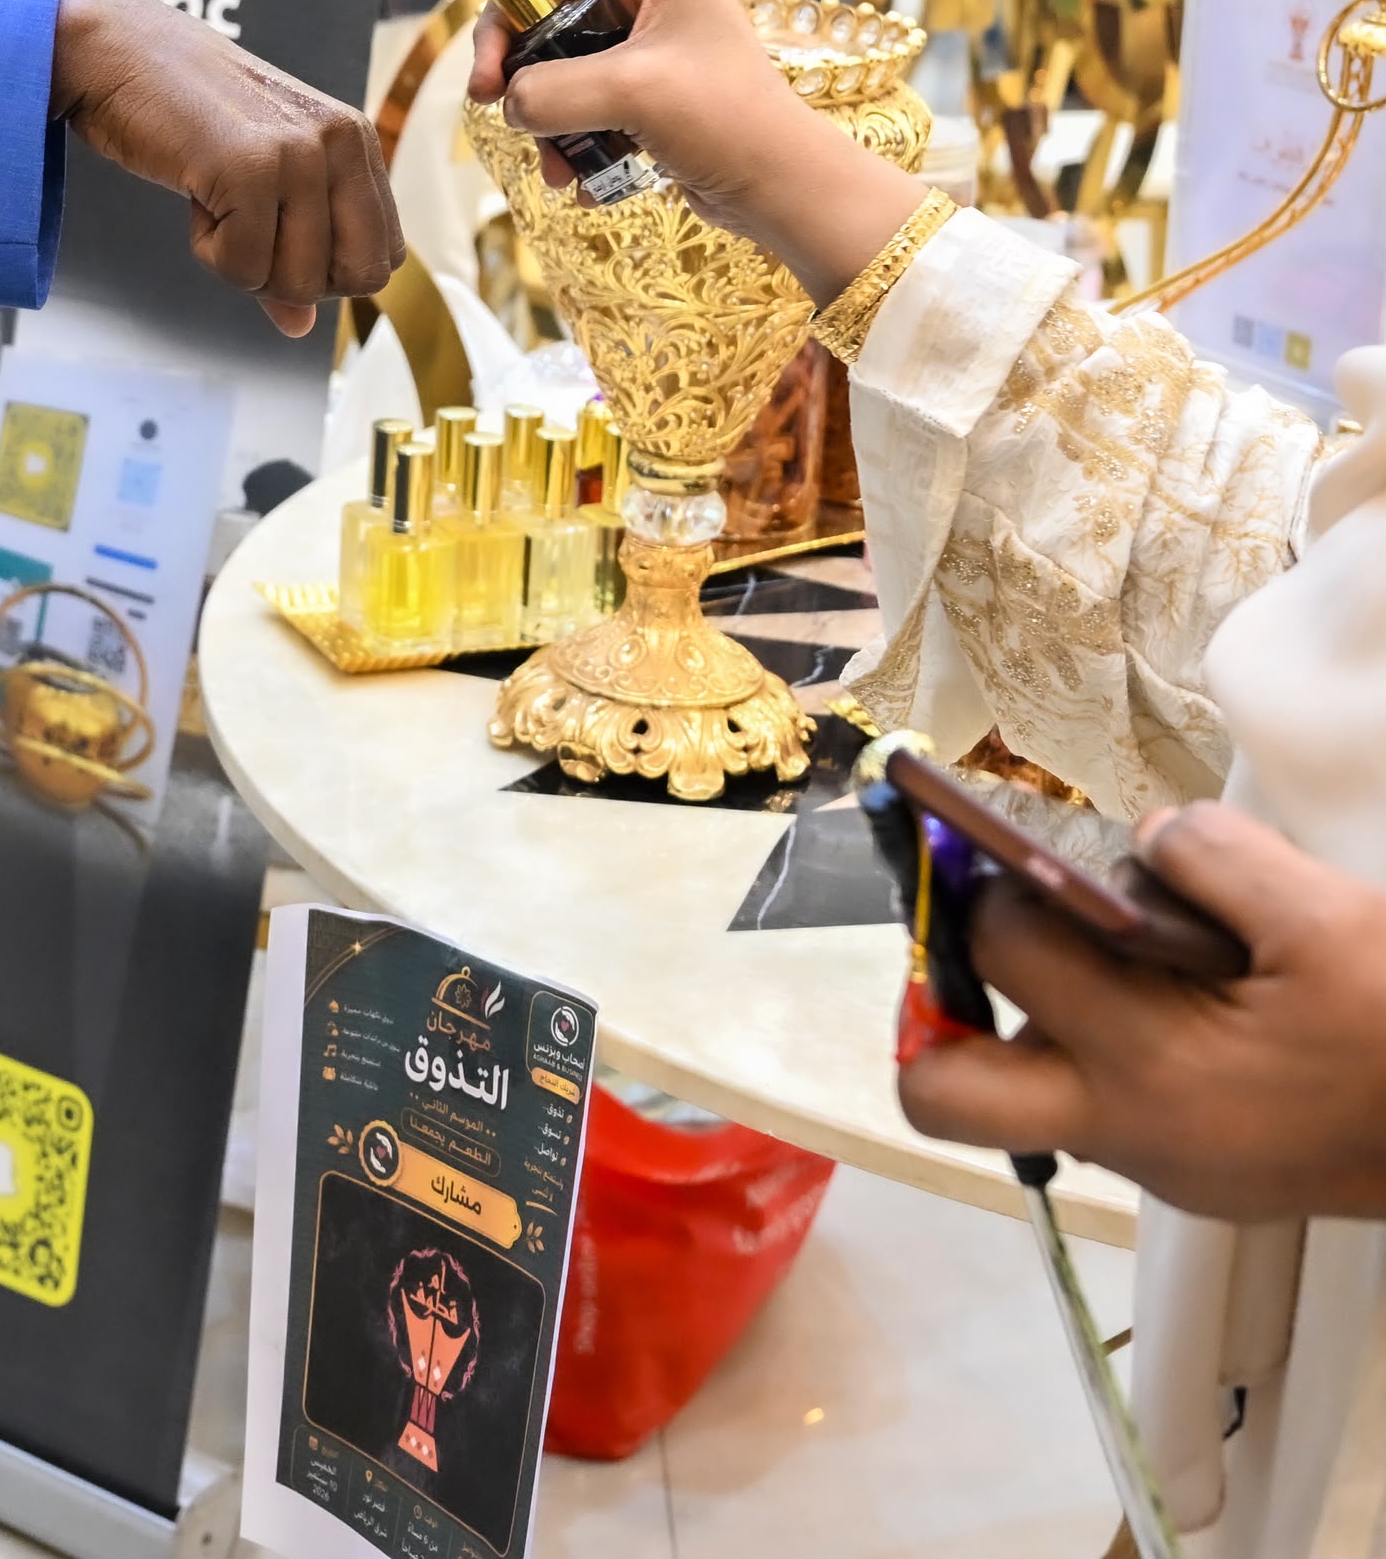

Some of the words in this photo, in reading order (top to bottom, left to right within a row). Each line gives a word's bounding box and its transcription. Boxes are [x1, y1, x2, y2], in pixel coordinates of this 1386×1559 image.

[426, 1010, 491, 1052] مهرجان
[404, 1034, 510, 1110] التذوق
[421, 1100, 449, 1114] الثاني
[449, 1112, 484, 1132] الموسم
[409, 1115, 446, 1147] يجمعنا
[449, 1139, 491, 1166] الطعم
[431, 1176, 482, 1215] مشارك
[409, 1281, 458, 1325] قطوف
